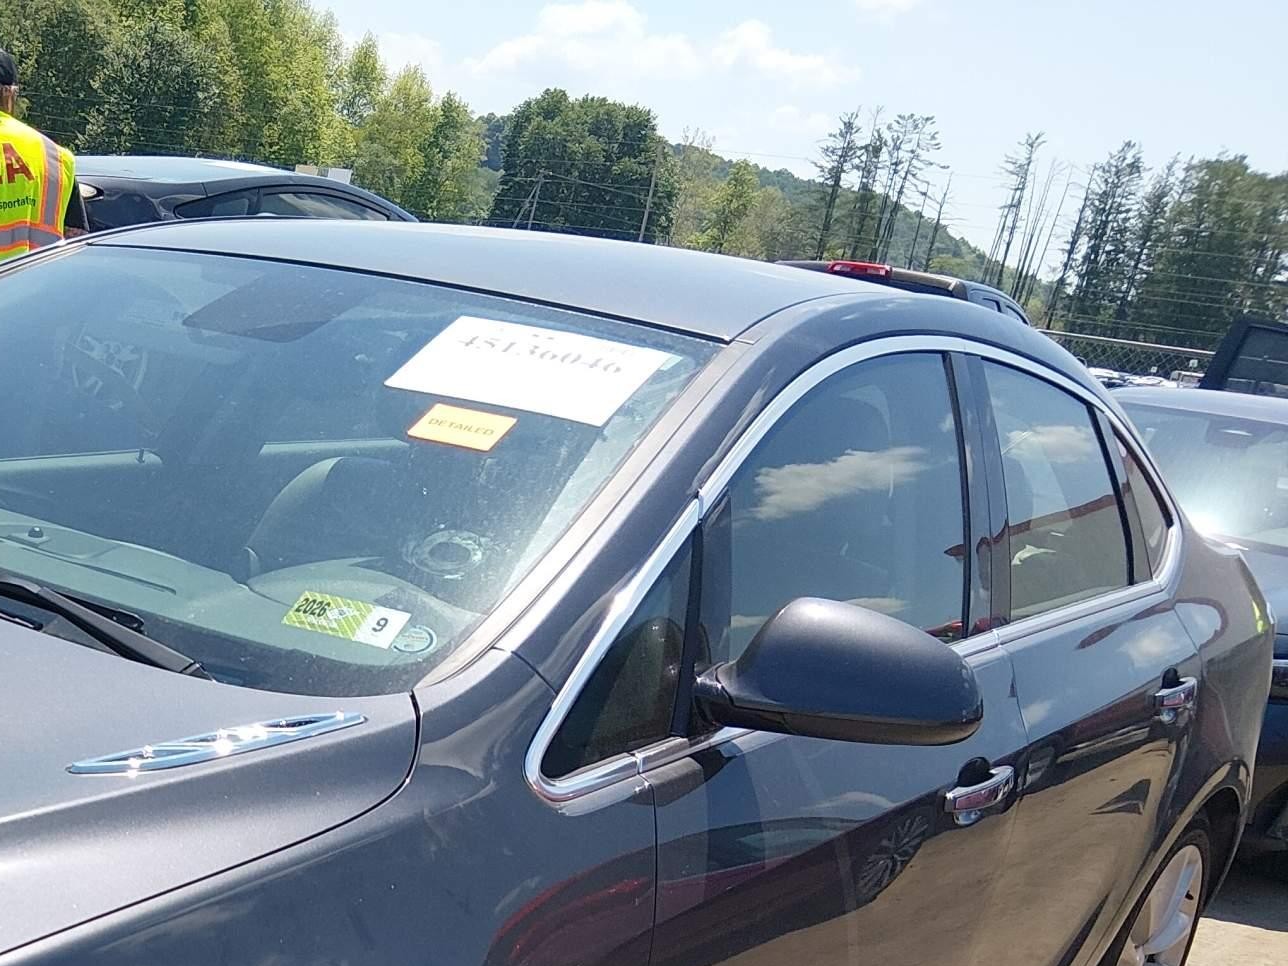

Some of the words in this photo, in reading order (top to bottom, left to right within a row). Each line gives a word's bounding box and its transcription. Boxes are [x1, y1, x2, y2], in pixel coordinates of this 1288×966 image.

[458, 335, 623, 375] 45136046
[428, 417, 495, 437] DETAILED
[294, 597, 332, 618] 2026
[371, 617, 389, 633] 9
